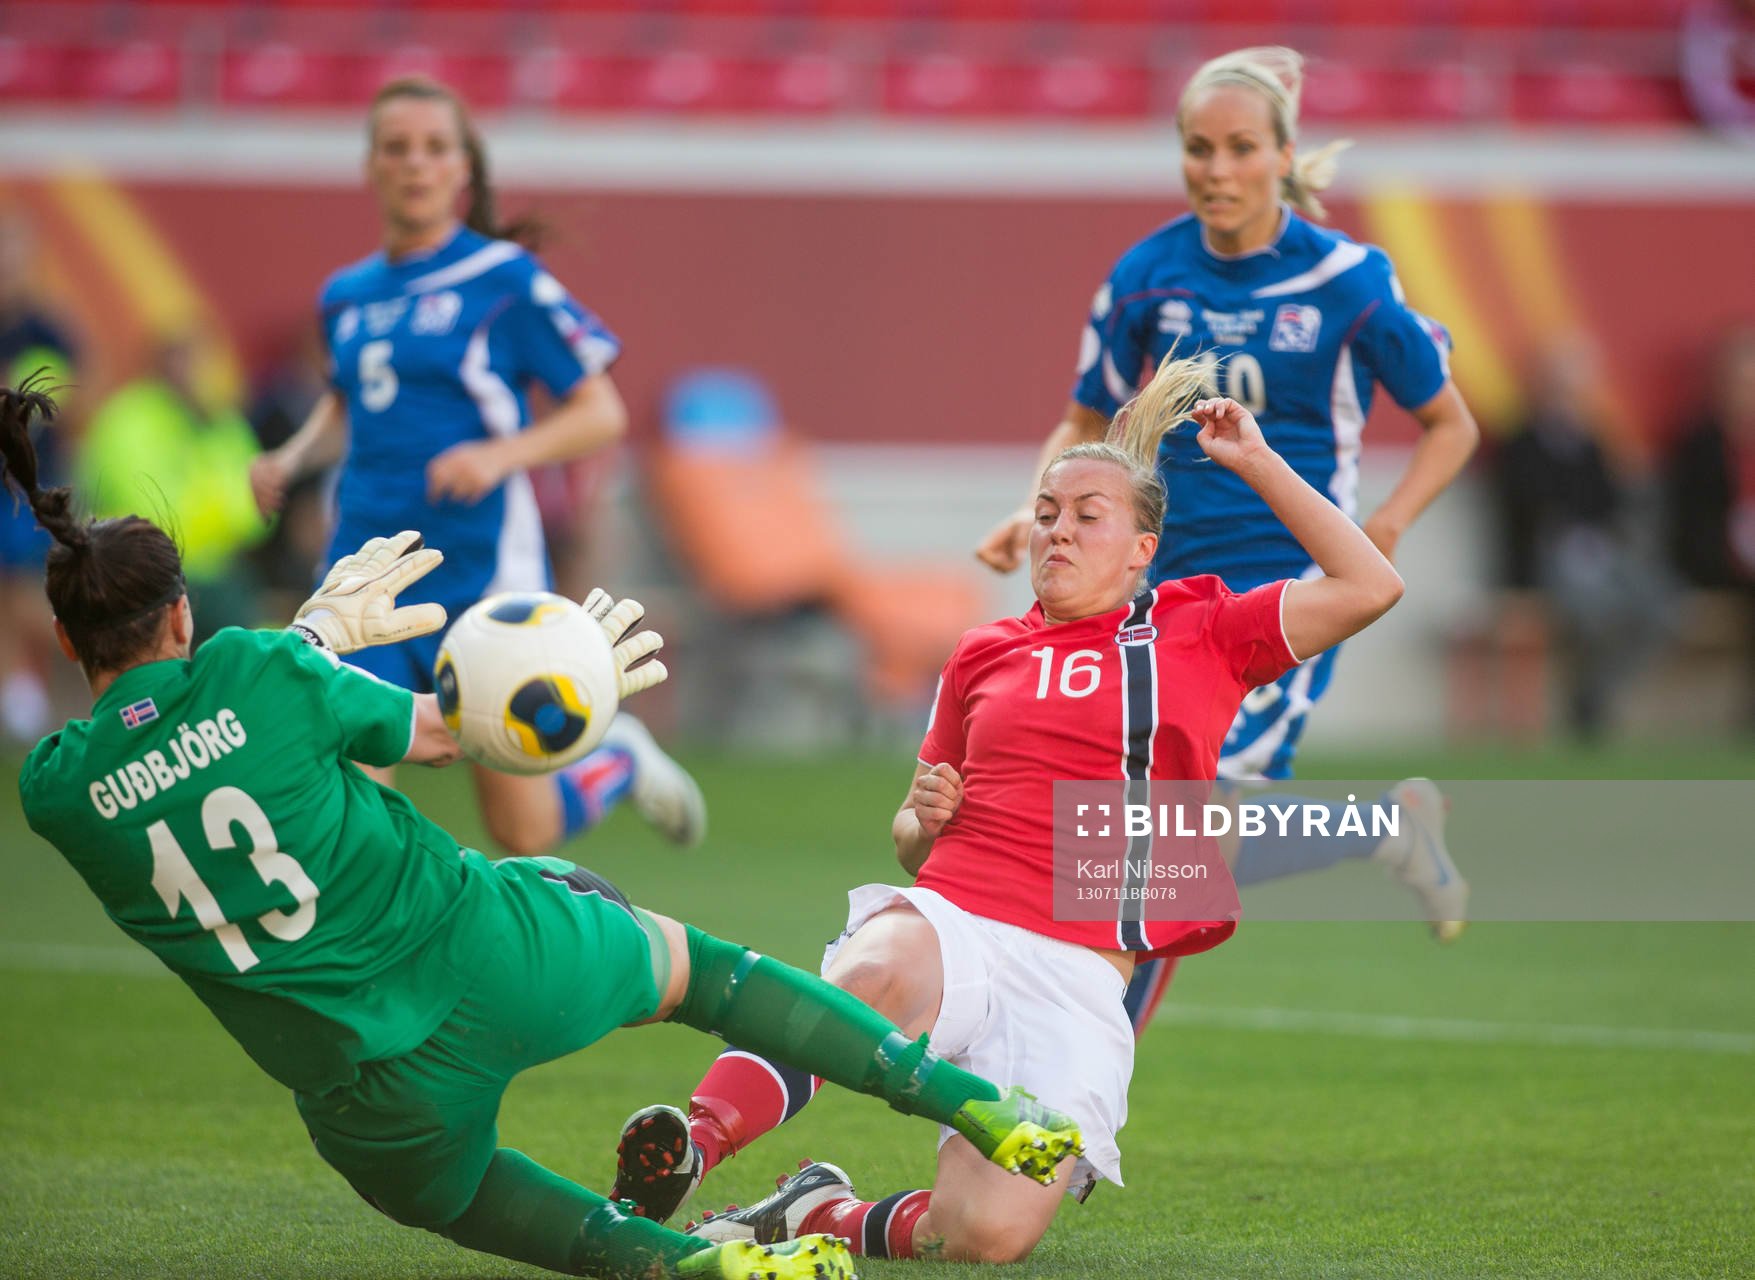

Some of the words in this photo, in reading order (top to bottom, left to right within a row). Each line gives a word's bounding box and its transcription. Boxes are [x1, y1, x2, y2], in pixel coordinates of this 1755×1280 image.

[358, 339, 399, 413] 5
[1031, 646, 1103, 699] 16
[89, 708, 247, 819] GUÐBJÖRG
[146, 786, 320, 973] 13
